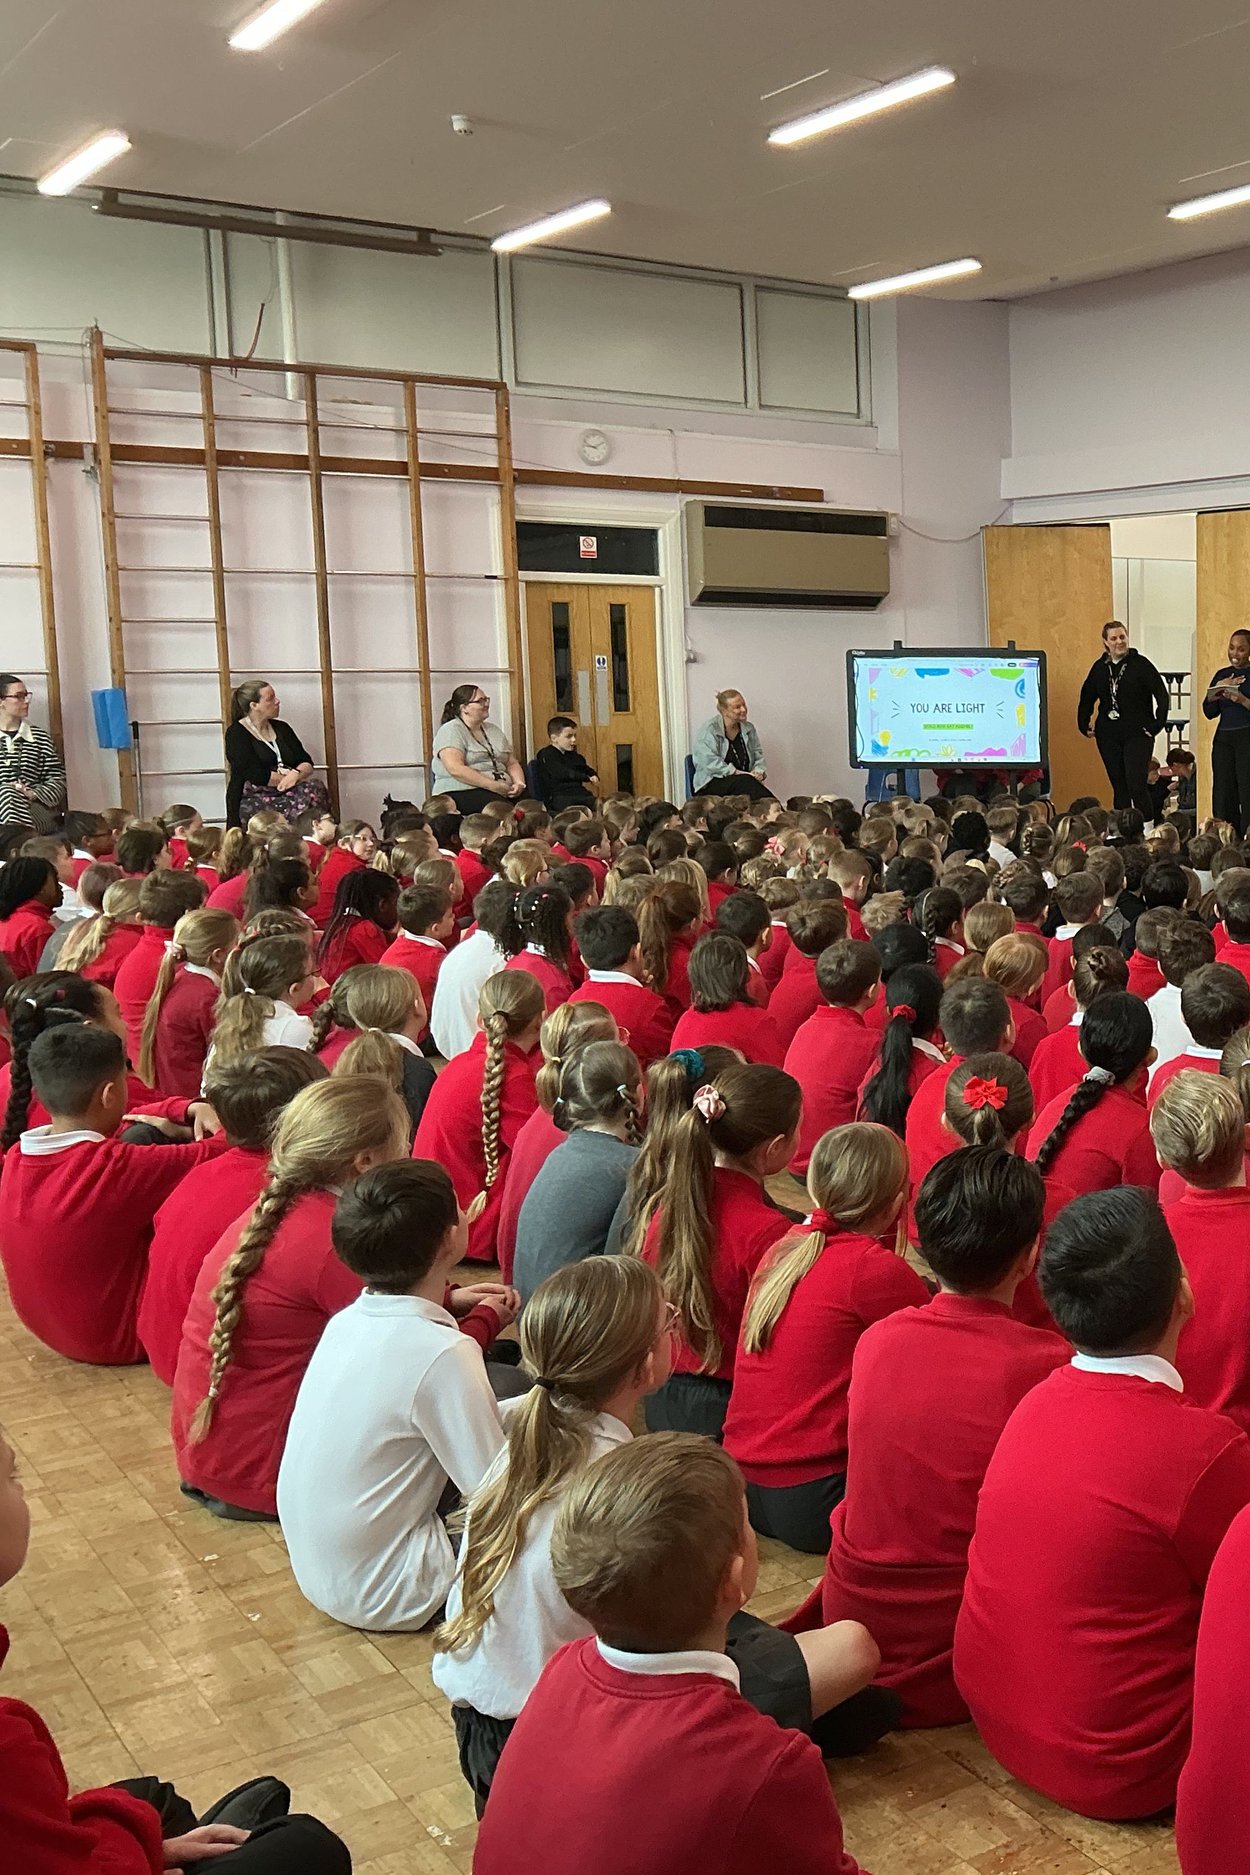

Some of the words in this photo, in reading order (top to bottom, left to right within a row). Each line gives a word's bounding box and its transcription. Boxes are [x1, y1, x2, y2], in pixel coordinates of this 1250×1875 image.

[910, 703, 929, 713] YOU
[933, 703, 952, 713] ARE
[956, 703, 985, 713] LIGHT
